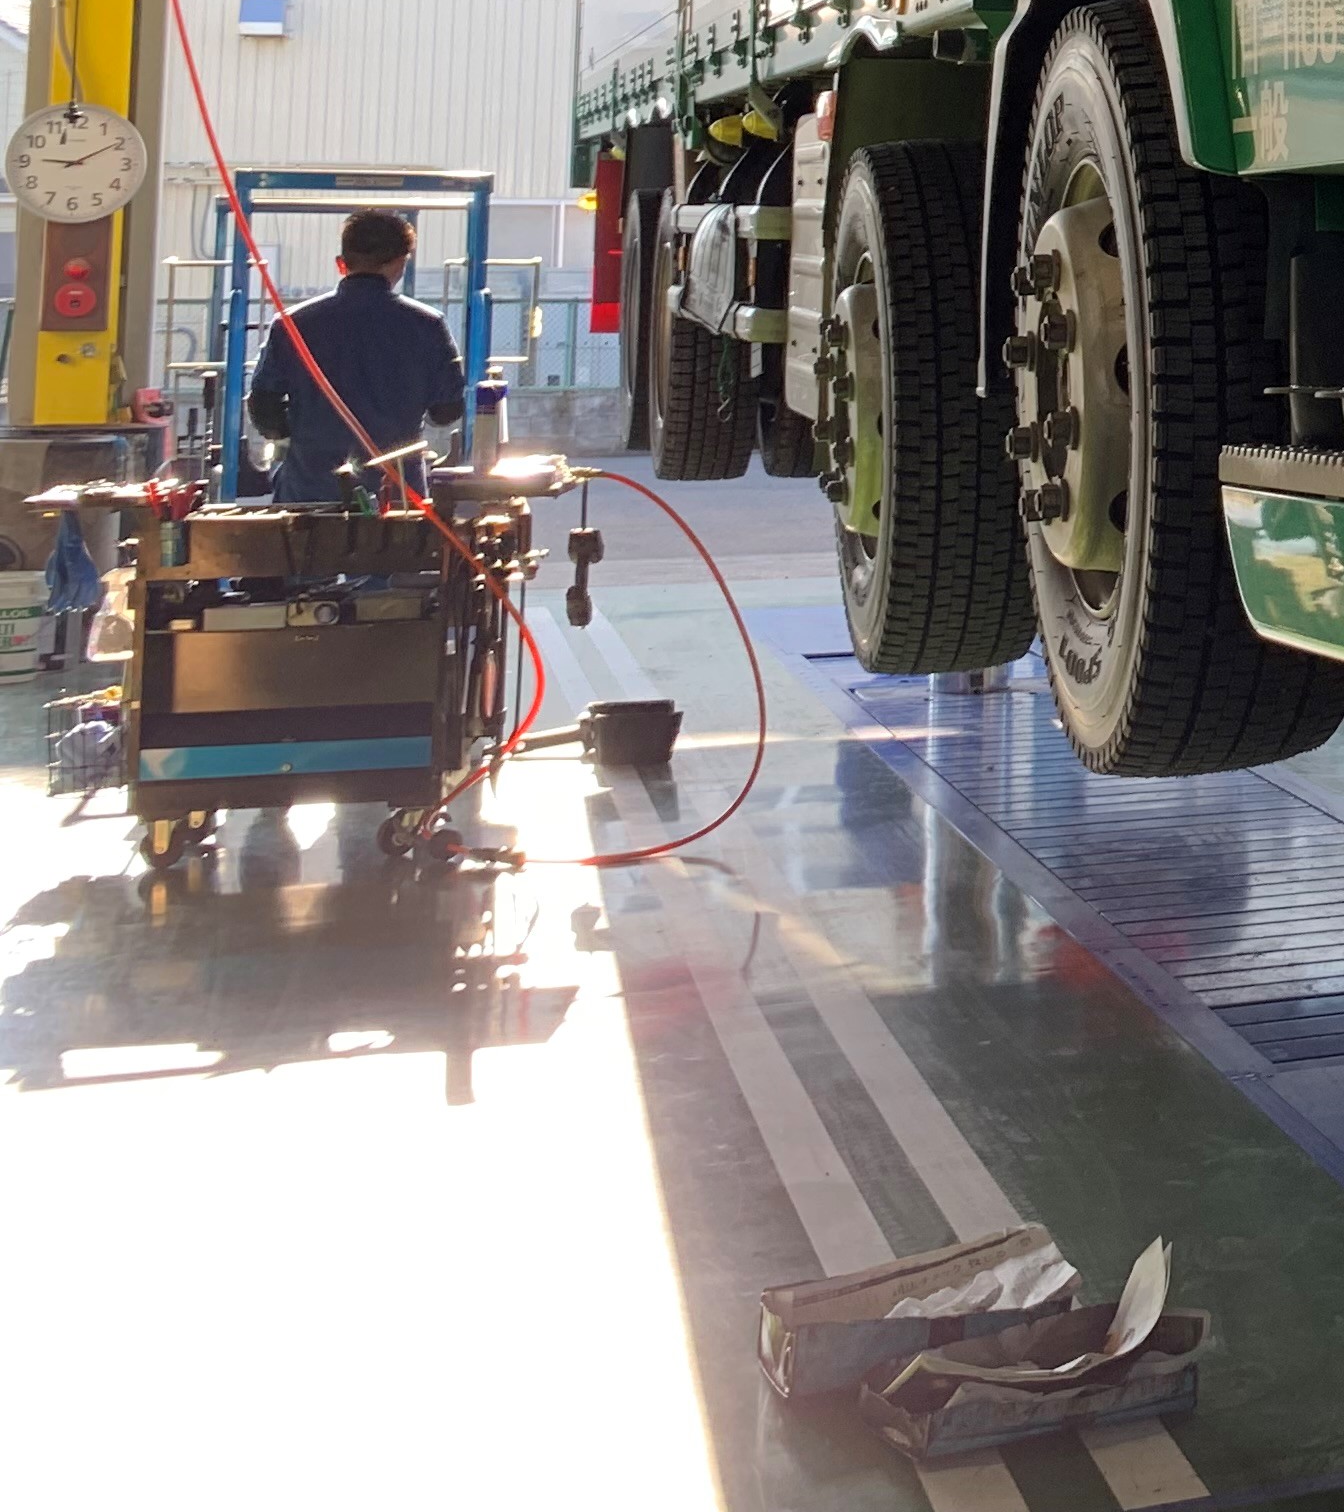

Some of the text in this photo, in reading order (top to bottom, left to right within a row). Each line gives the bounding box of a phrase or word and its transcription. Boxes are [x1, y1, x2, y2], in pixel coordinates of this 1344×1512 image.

[47, 120, 62, 134] 11
[100, 122, 108, 136] 1
[26, 134, 46, 148] 10
[114, 137, 126, 150] 2
[19, 154, 31, 168] 9
[120, 158, 132, 171] 3
[26, 175, 38, 189] 8
[109, 178, 122, 191] 4
[45, 191, 56, 205] 7
[66, 197, 79, 211] 6
[91, 193, 103, 206] 5
